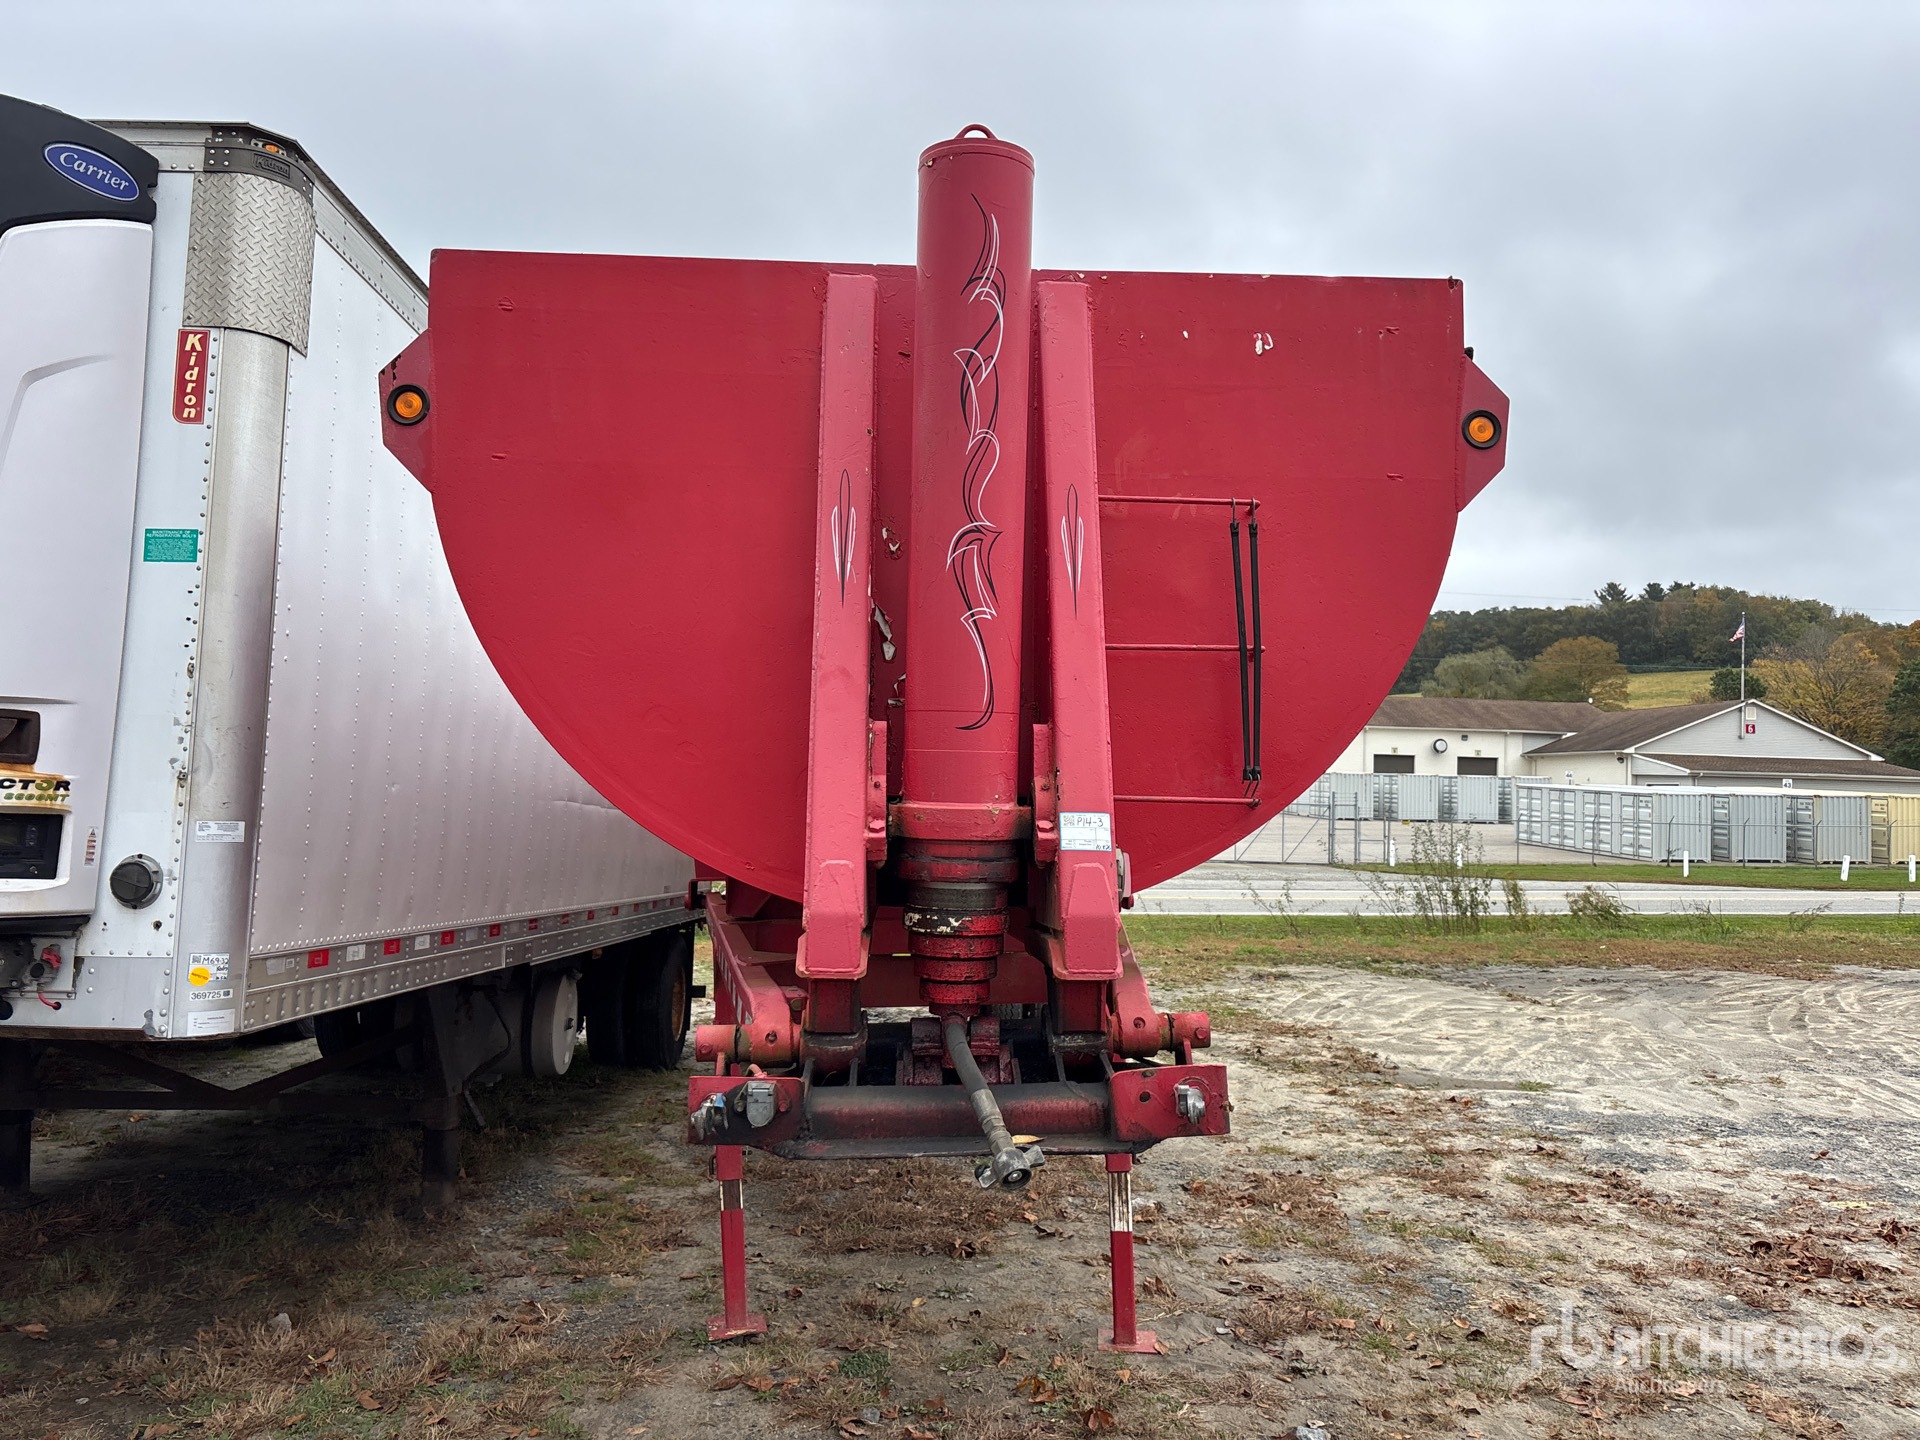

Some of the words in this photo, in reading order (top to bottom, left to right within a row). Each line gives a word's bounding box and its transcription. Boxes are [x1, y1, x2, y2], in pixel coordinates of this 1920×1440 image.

[60, 152, 129, 190] Carrier
[182, 333, 204, 418] Kidron
[1076, 816, 1104, 828] P14-3
[190, 990, 222, 1000] 369725
